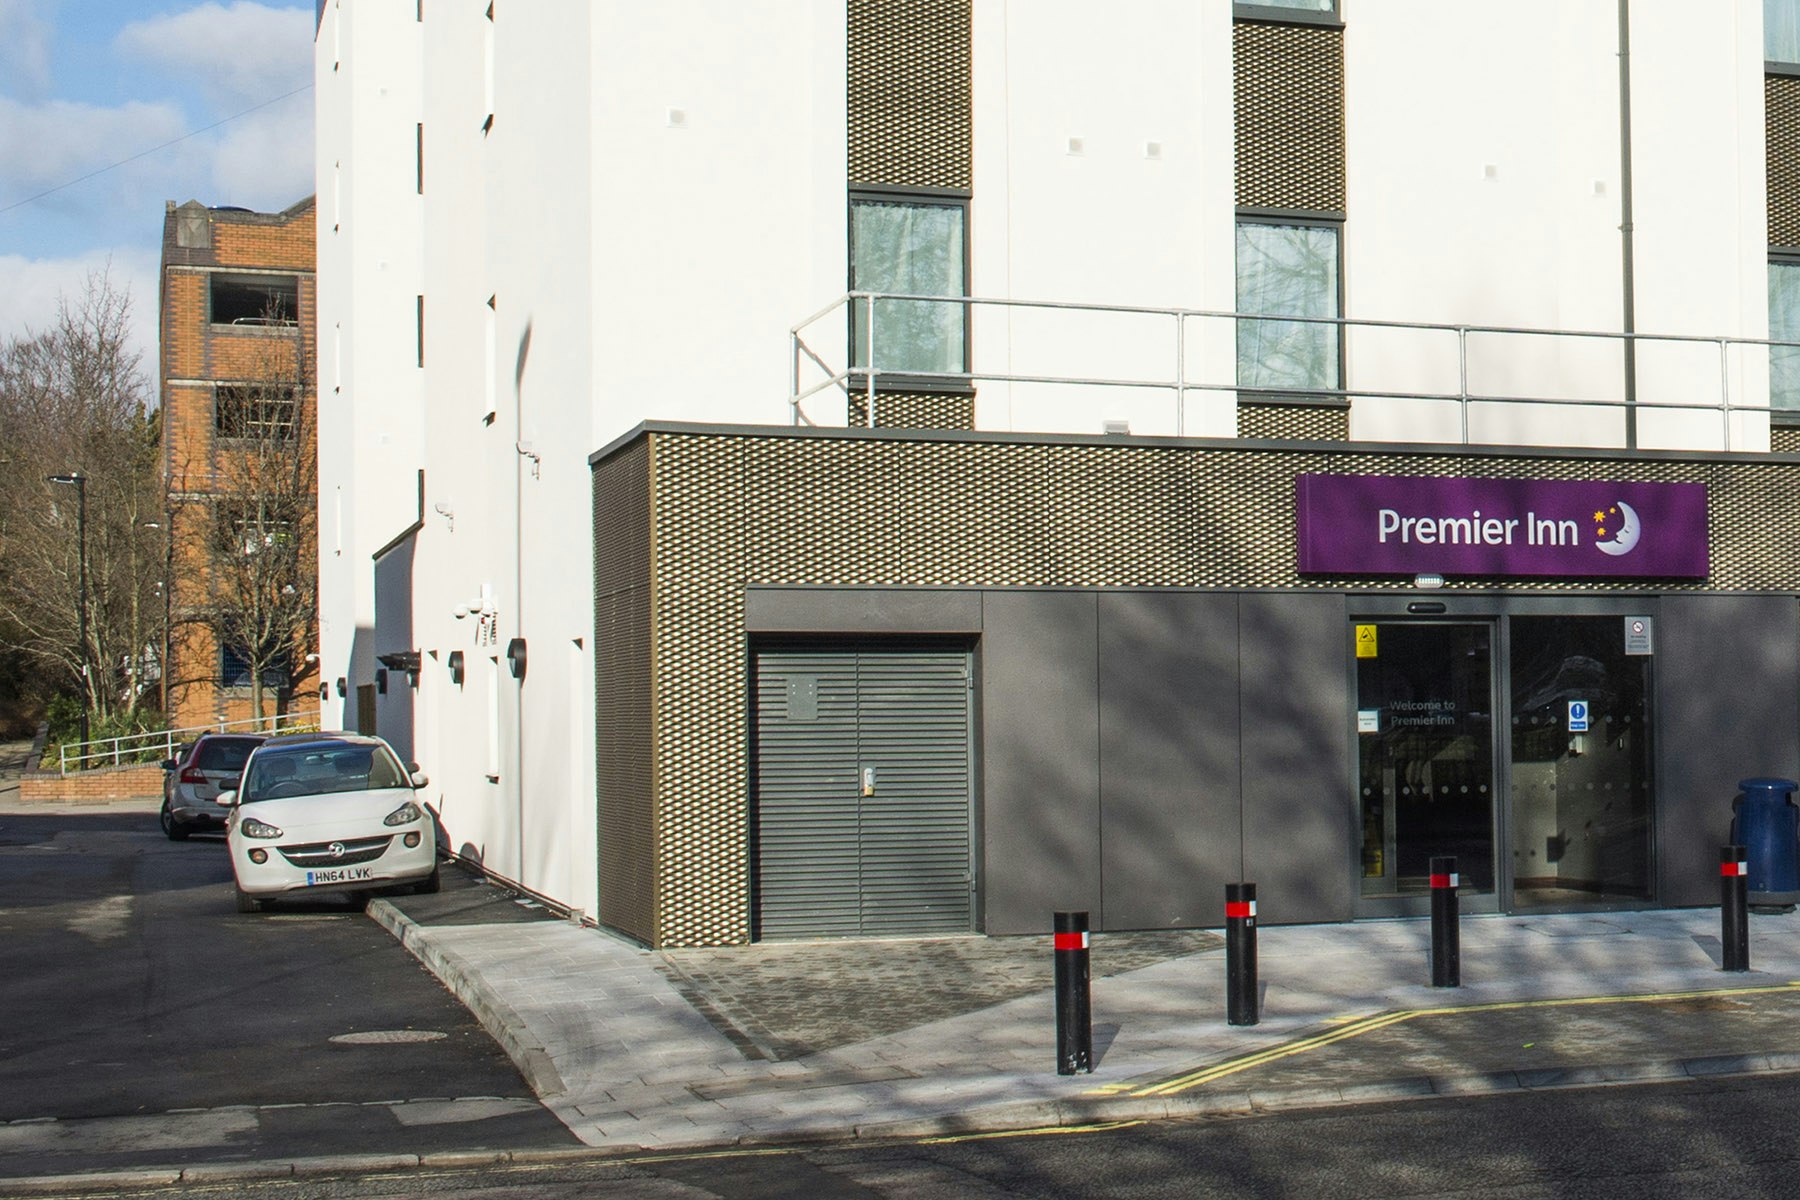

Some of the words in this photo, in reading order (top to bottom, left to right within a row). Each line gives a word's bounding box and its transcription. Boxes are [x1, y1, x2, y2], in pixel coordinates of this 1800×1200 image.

[1378, 509, 1519, 545] Premier
[1527, 512, 1579, 546] Inn
[1389, 700, 1442, 711] Welcome
[1444, 701, 1456, 711] to
[1391, 715, 1435, 726] Premier
[1437, 715, 1456, 726] Inn
[315, 870, 345, 883] HN64
[347, 868, 371, 880] LVK
